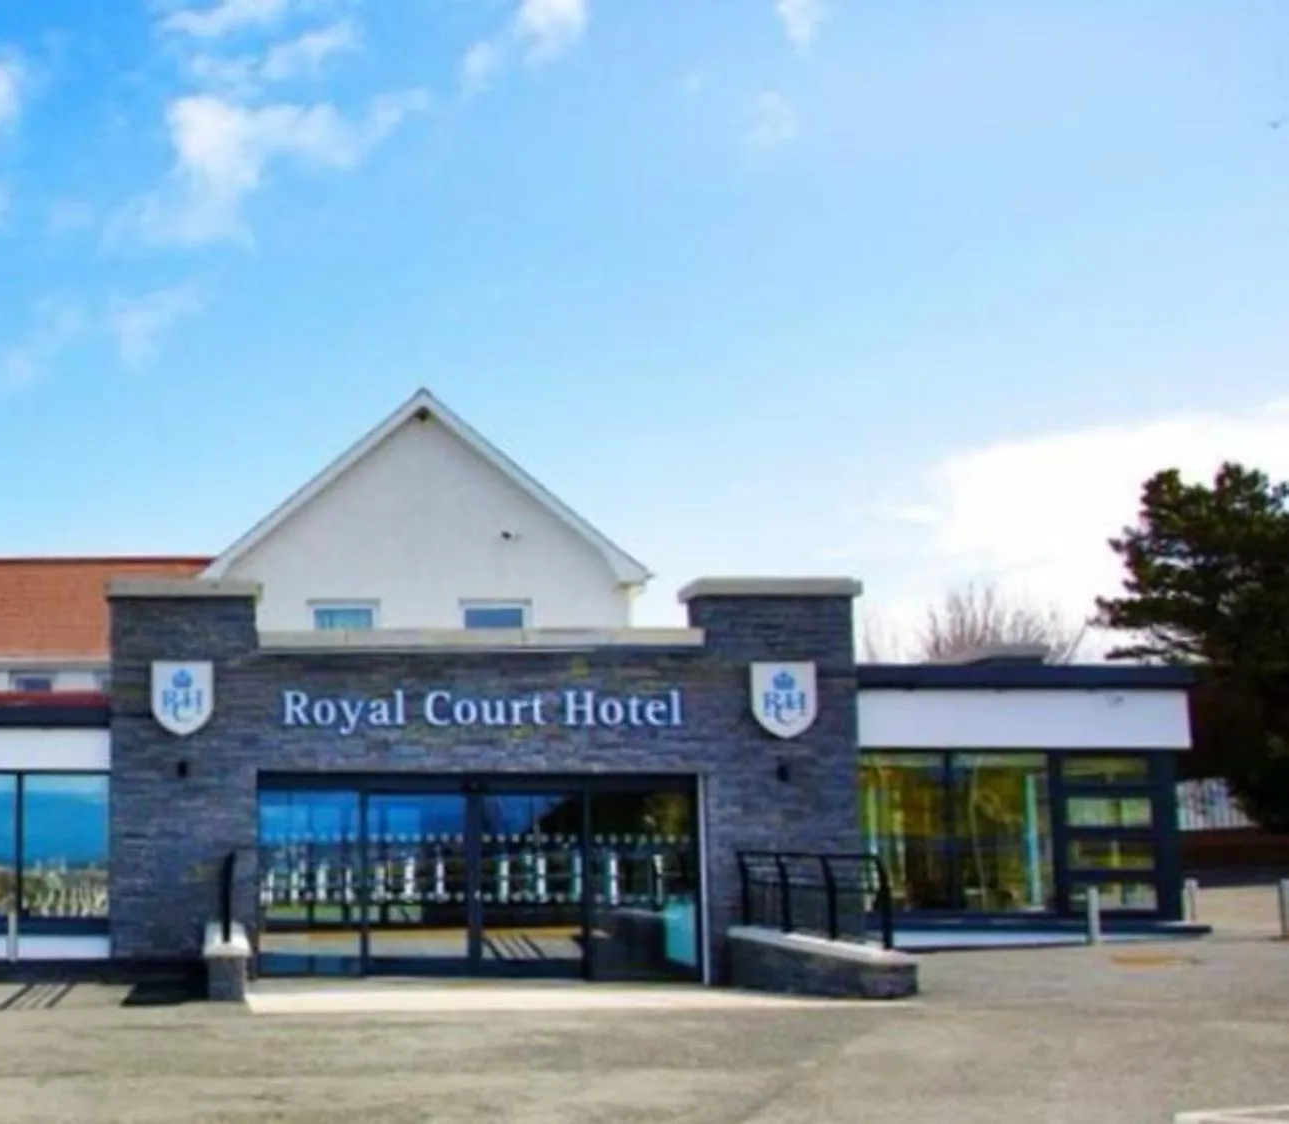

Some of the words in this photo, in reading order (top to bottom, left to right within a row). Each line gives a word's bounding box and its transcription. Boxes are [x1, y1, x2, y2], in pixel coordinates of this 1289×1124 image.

[282, 689, 406, 734] Royal
[423, 690, 547, 726] Court
[563, 689, 683, 726] Hotel
